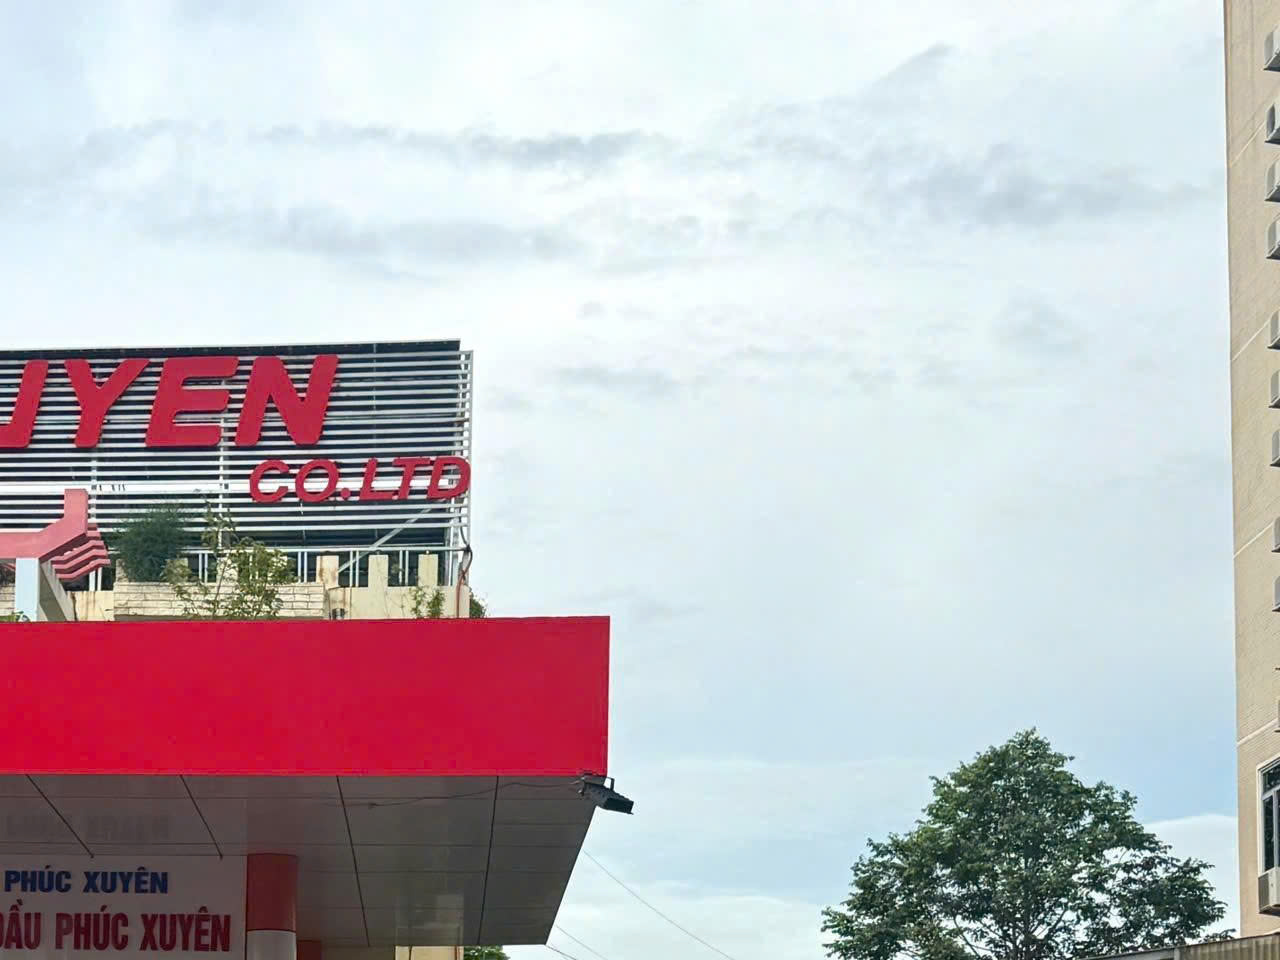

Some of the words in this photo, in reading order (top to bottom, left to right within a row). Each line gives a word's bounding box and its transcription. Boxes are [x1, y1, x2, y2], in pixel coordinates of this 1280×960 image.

[4, 865, 72, 894] PHÚC
[82, 866, 169, 894] XUYÊN
[55, 904, 129, 951] PHÚC
[139, 906, 231, 952] XUYÊN
